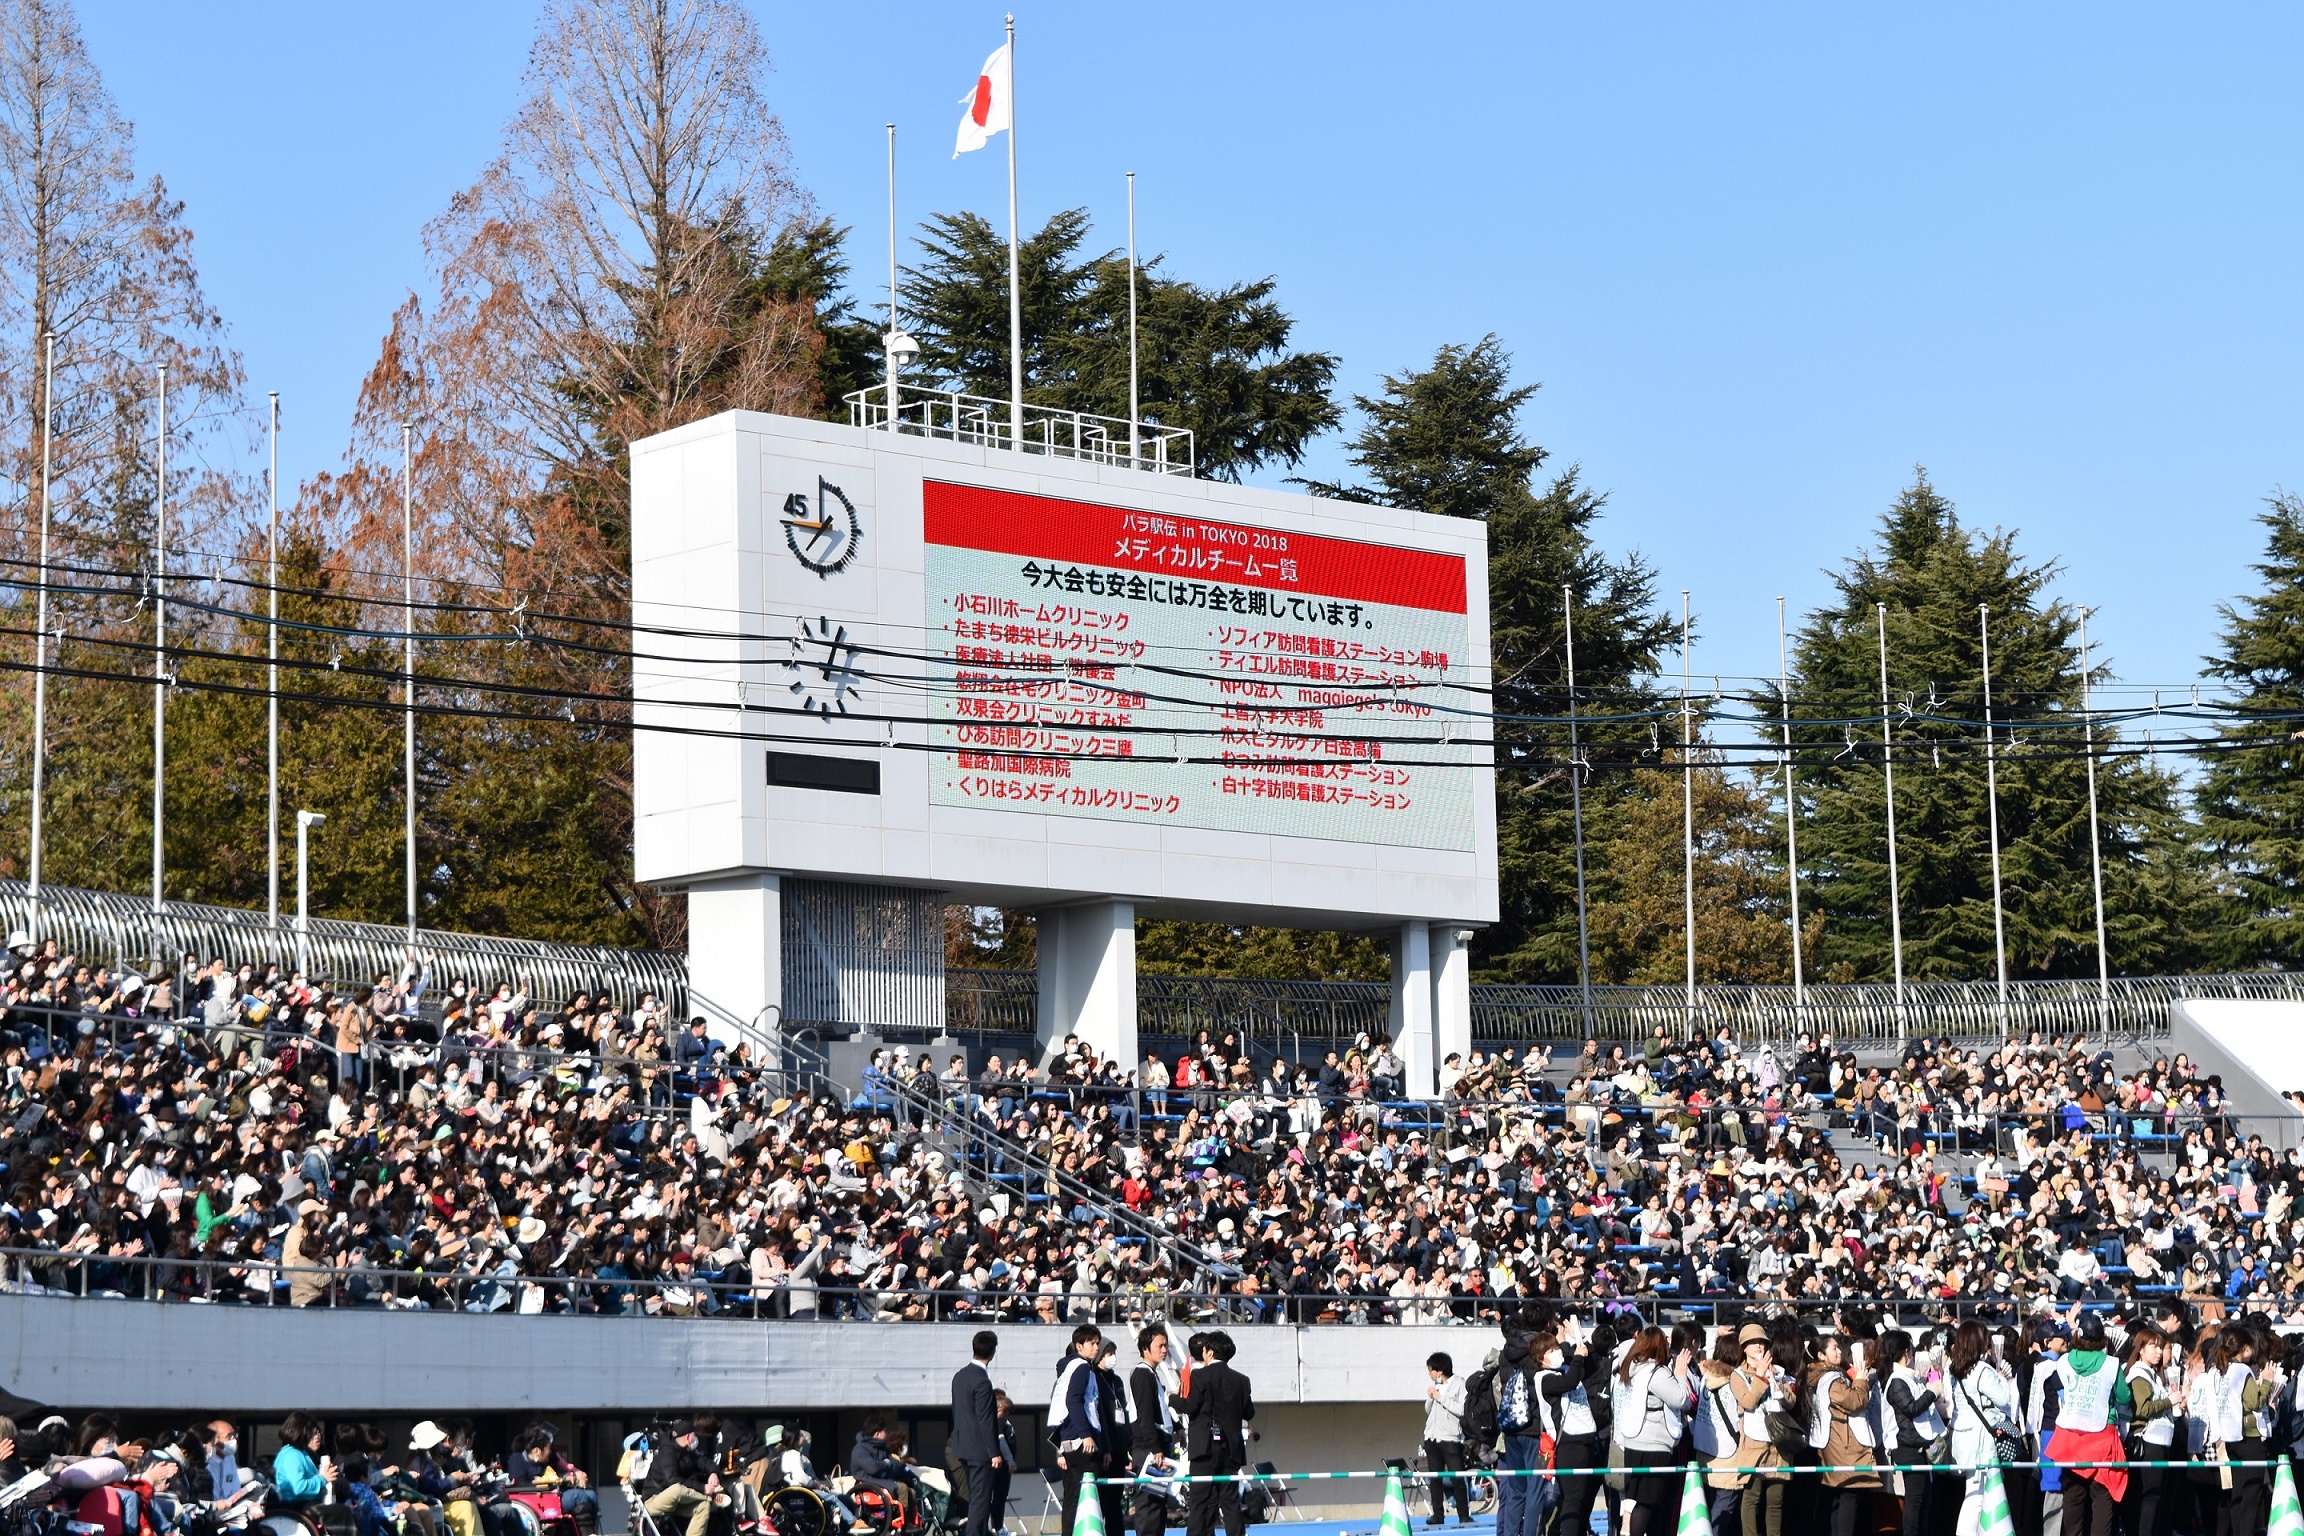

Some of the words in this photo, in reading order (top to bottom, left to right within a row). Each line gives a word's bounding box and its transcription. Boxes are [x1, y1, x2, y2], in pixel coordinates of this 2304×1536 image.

[783, 493, 807, 517] 45
[1122, 514, 1178, 538] パラ駅伝
[1182, 522, 1195, 539] in
[1200, 525, 1248, 546] TOKYO
[1253, 533, 1288, 551] 2018
[1114, 537, 1298, 582] メディカルチーム一覧
[1021, 560, 1373, 630] 今大会も安全には万全を期しています。
